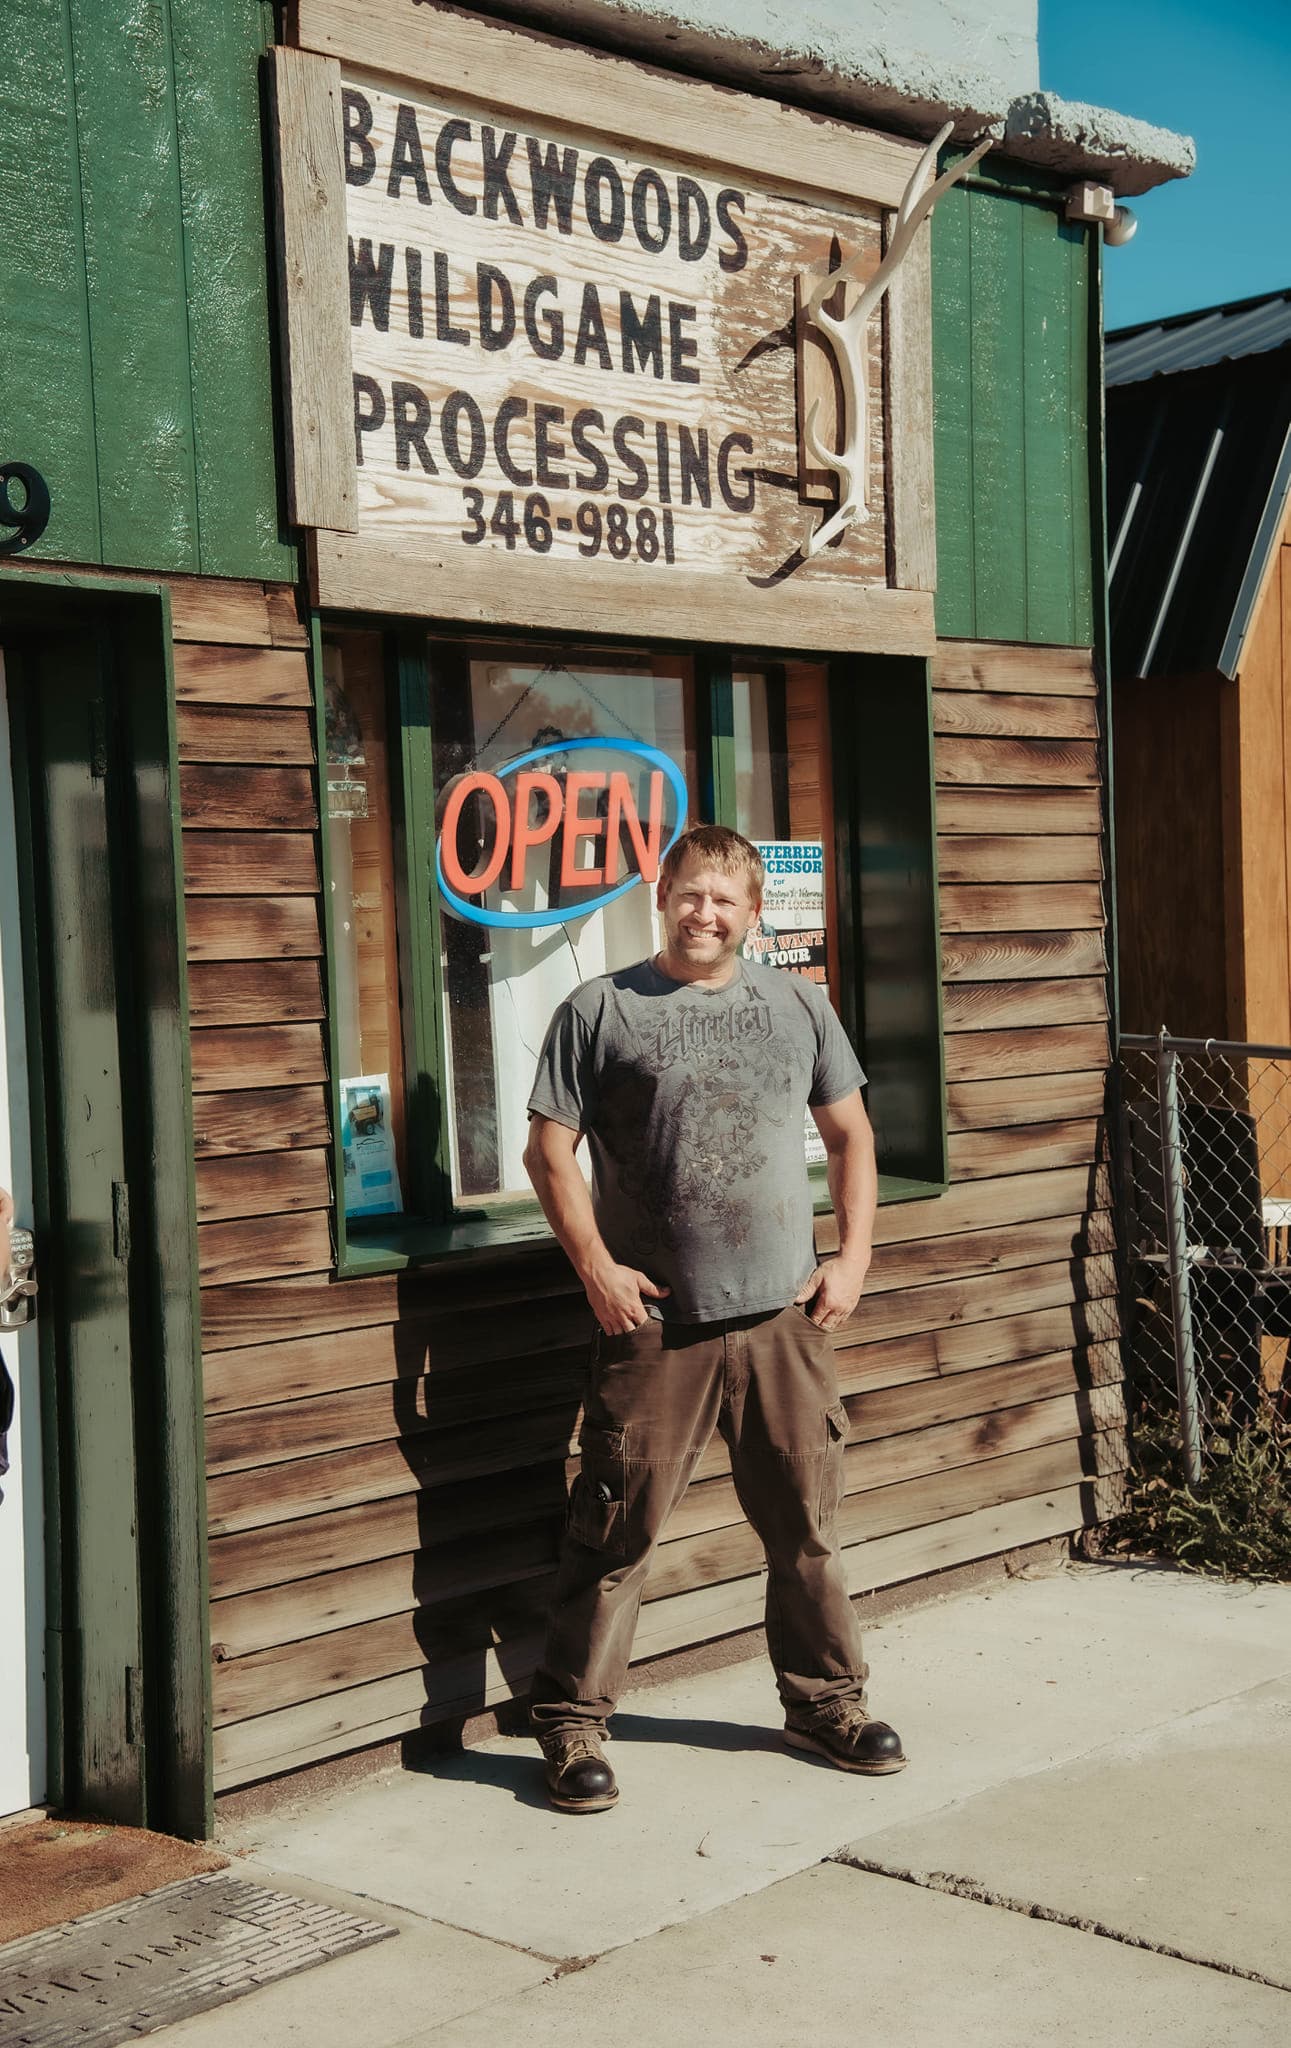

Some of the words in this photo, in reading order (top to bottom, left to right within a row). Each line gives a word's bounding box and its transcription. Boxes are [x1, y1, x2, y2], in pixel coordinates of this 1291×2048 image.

[341, 87, 748, 273] BACKWOODS
[348, 234, 700, 384] WILDGAME
[352, 372, 756, 513] PROCESSING
[461, 486, 676, 565] 346-9881
[441, 771, 664, 894] OPEN
[758, 845, 823, 859] EFERRED
[763, 860, 823, 873] CESSOR
[753, 937, 776, 953] WE
[777, 930, 825, 950] WANT
[768, 948, 811, 966] YOUR
